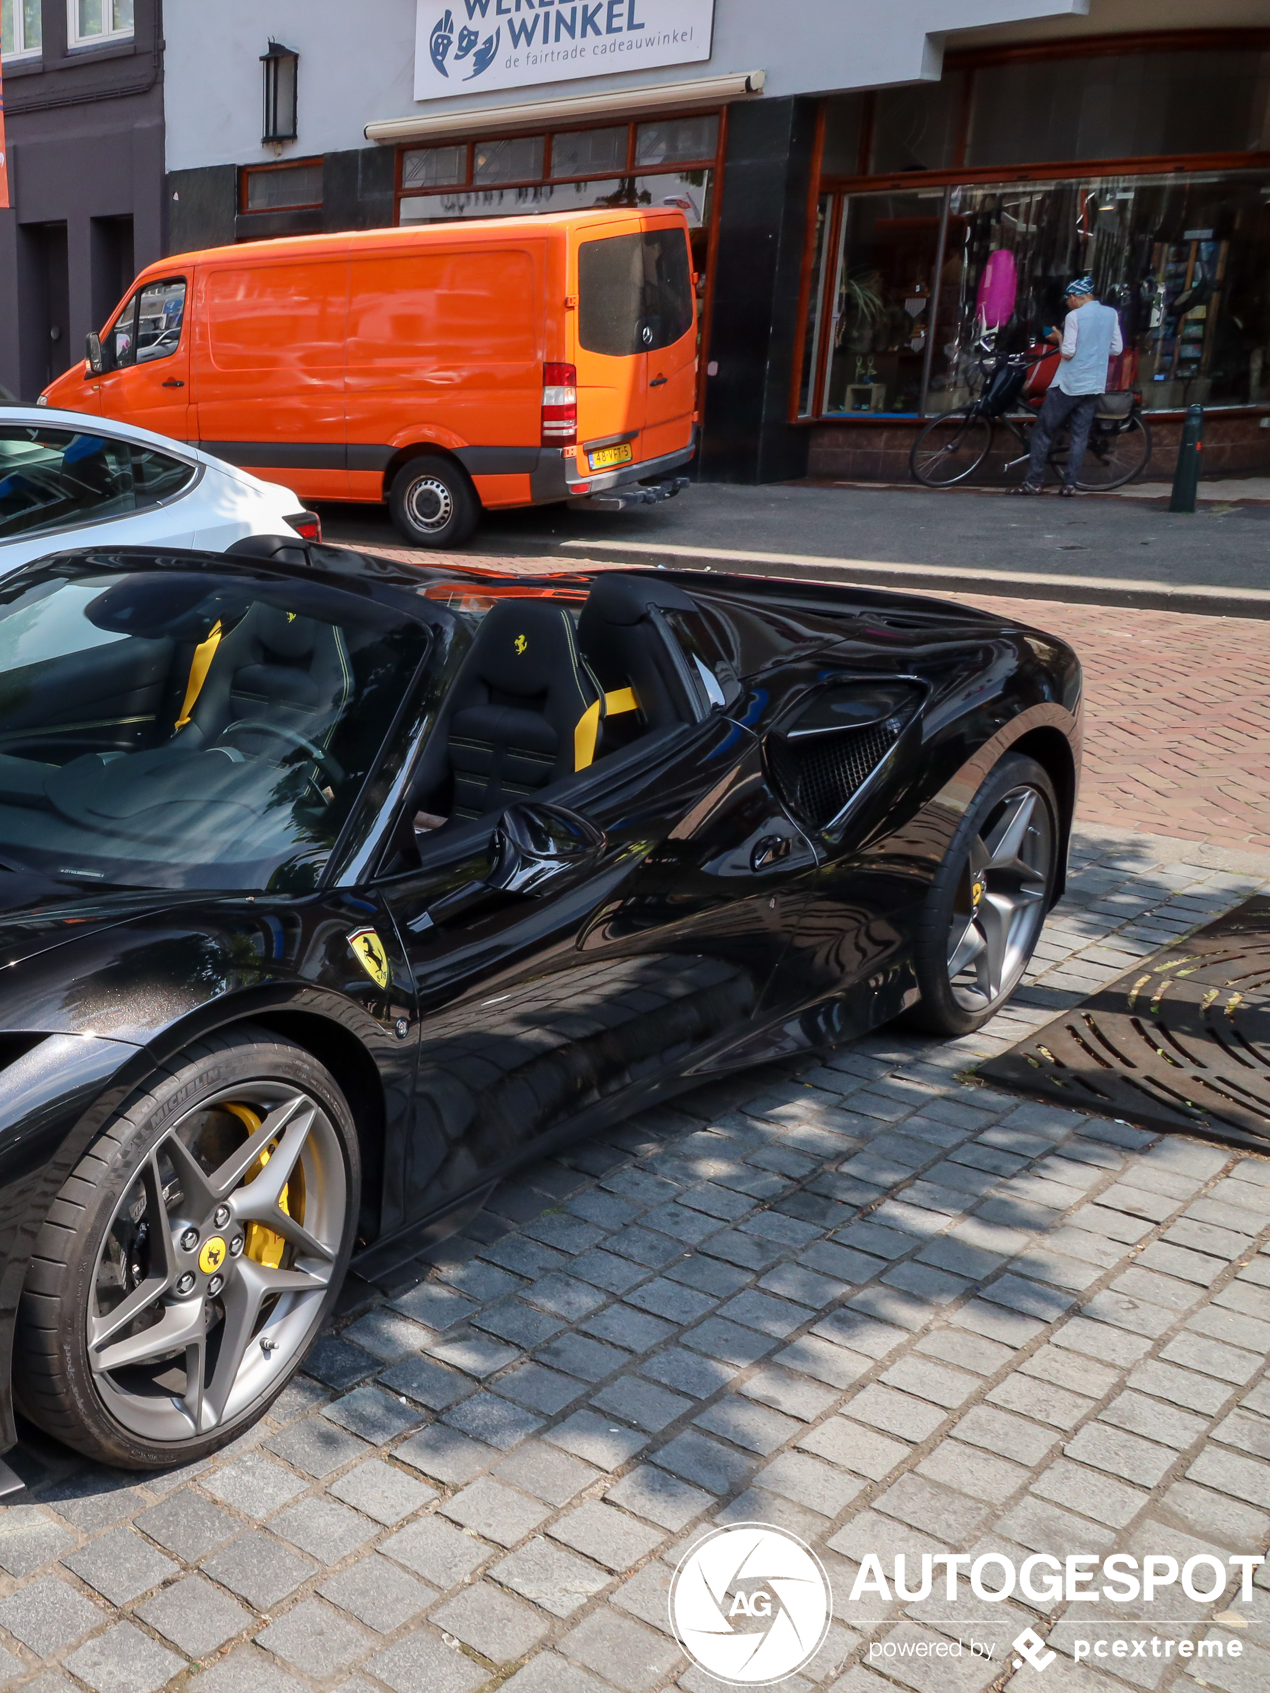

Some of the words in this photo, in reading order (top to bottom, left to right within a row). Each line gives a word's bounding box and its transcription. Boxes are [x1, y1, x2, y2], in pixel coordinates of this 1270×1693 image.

[505, 56, 520, 69] de
[526, 46, 587, 67] fairtrade
[592, 27, 694, 57] cadeauwinkel
[507, 0, 645, 50] WINKEL
[150, 1066, 220, 1129] MICHELIN
